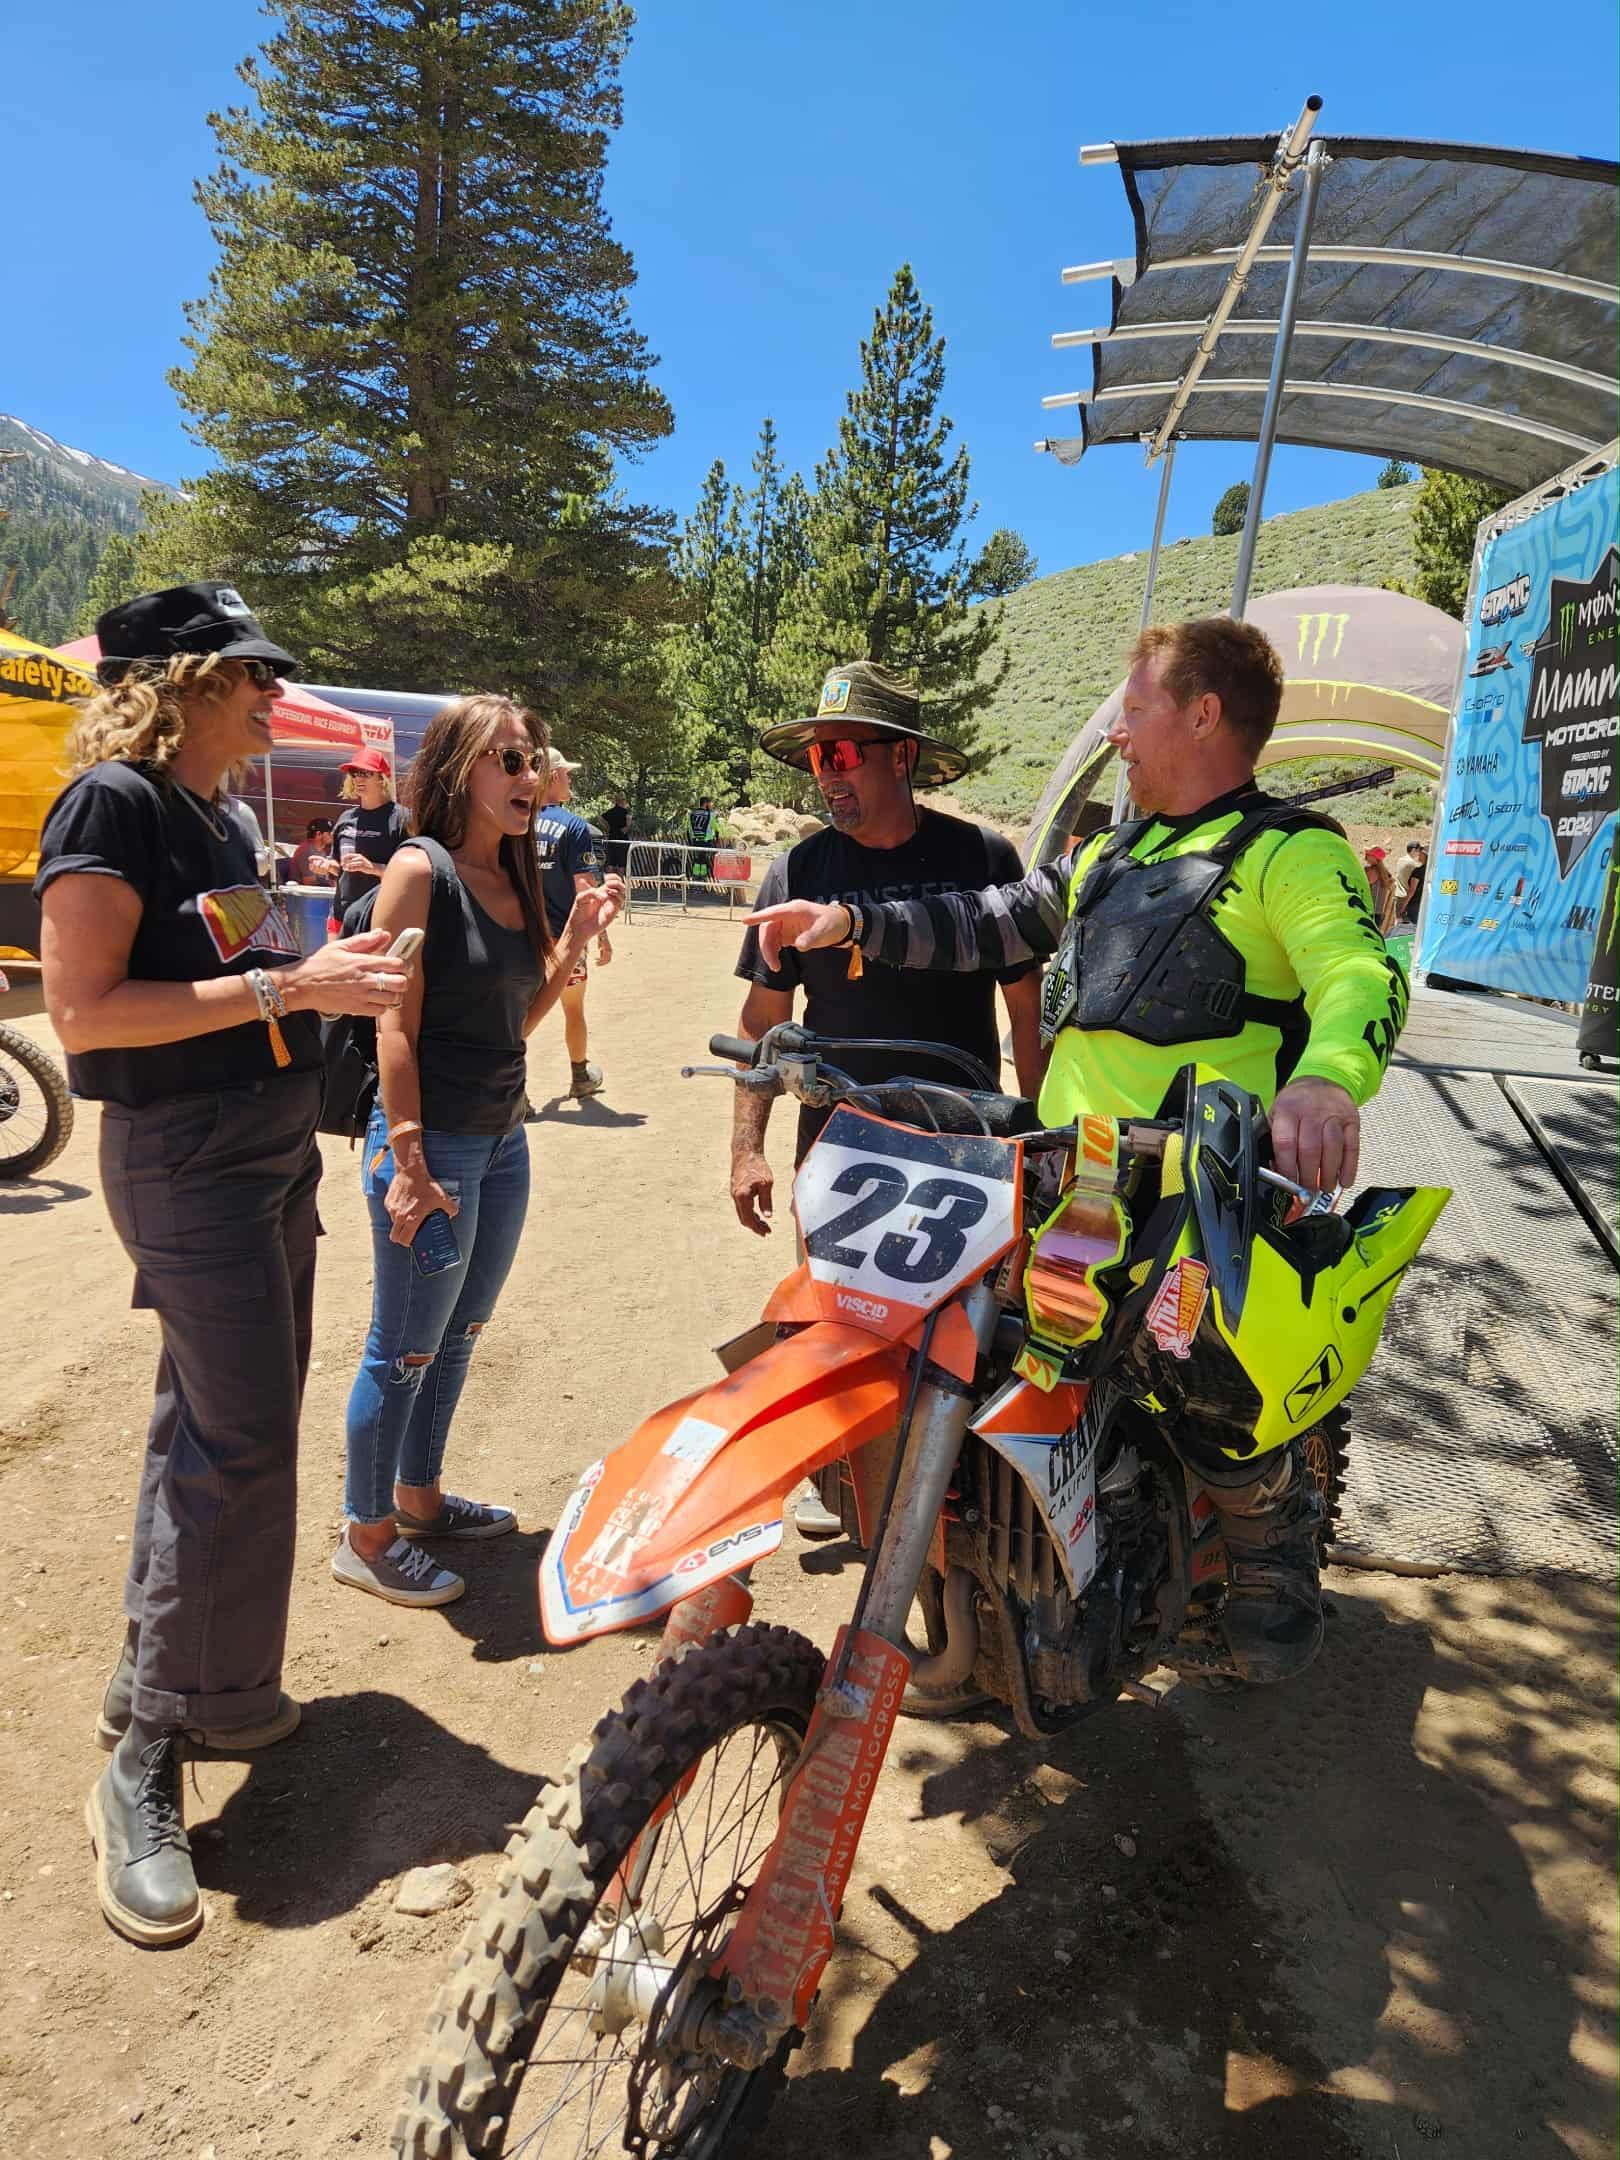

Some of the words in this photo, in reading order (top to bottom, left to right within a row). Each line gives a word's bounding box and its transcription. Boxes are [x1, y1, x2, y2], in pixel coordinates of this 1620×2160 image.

[0, 656, 64, 697] afety
[1465, 694, 1504, 711] GoPro
[1466, 753, 1498, 776] YAMAHA
[1556, 816, 1593, 837] 2024
[806, 1162, 988, 1284] 23
[708, 1525, 762, 1558] EVS
[849, 1661, 905, 1813] MOTOCROSS
